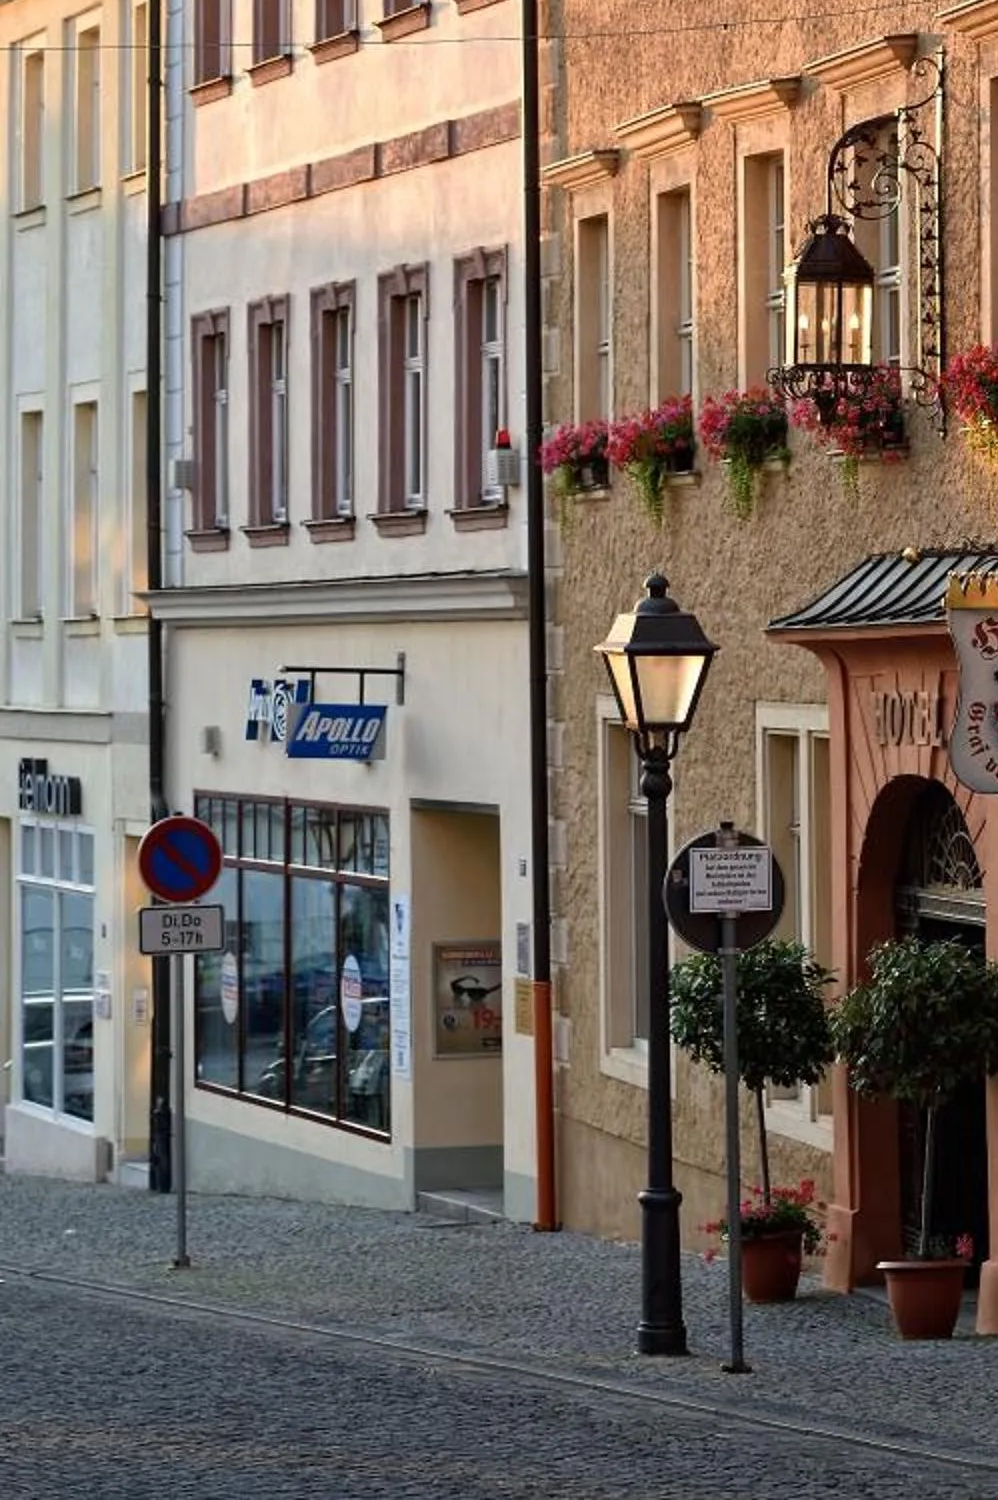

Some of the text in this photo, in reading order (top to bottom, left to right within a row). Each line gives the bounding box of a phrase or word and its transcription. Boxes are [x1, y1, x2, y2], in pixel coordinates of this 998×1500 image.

[296, 711, 381, 742] APOLLO
[871, 690, 943, 748] HOTEL
[967, 701, 990, 757] Graf
[329, 743, 369, 755] OPTIK
